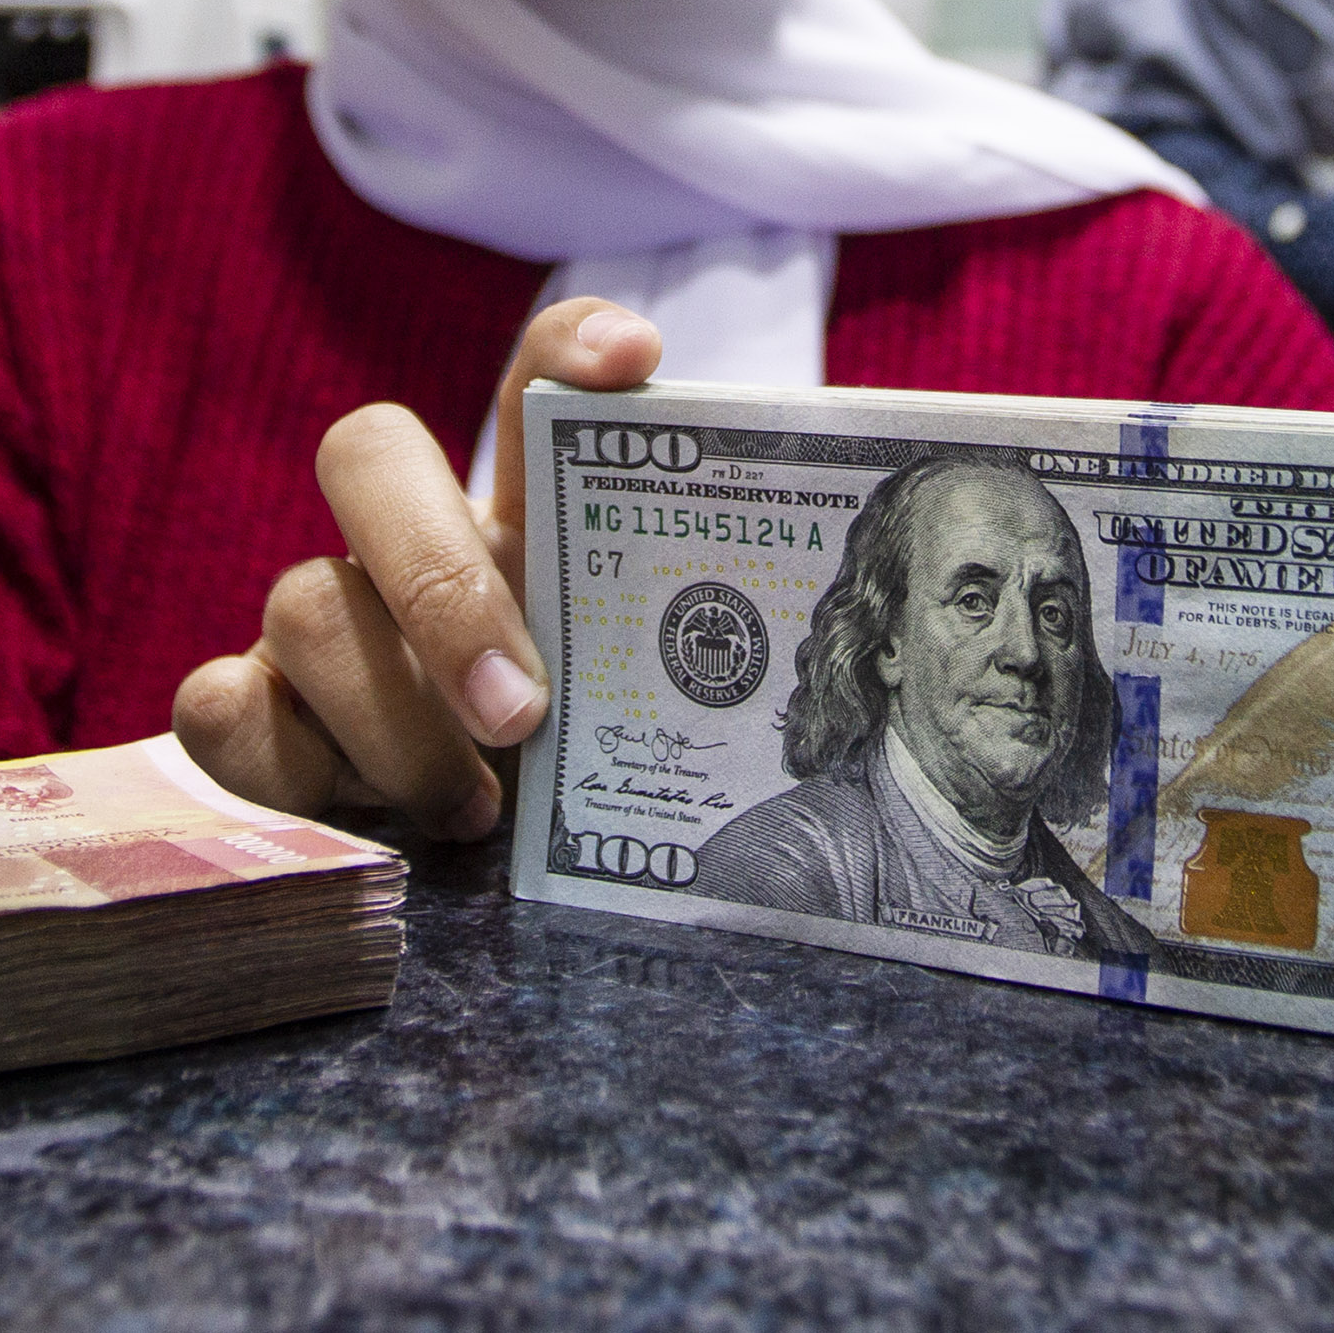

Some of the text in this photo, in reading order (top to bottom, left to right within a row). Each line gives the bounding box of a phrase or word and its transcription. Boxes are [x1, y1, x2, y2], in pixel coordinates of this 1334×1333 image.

[567, 428, 702, 473] 100
[1029, 453, 1100, 477] ONE
[582, 475, 859, 510] FEDERAL RESERVE NOTE
[632, 506, 795, 548] 11545124
[807, 522, 824, 551] A
[1093, 510, 1287, 555] UNITED
[1136, 552, 1207, 588] OF
[674, 589, 754, 624] UNITED STATES
[1178, 612, 1203, 623] FOR
[1208, 614, 1230, 625] ALL
[1285, 620, 1333, 634] PUBLIC
[1208, 602, 1237, 614] THIS
[1242, 604, 1275, 617] NOTE
[1280, 607, 1292, 618] IS
[665, 626, 763, 701] FEDERAL RESERVE SYSTEM
[611, 757, 647, 773] Secretary
[649, 762, 659, 774] of
[661, 762, 671, 775] the
[585, 798, 622, 813] Treasurer
[623, 803, 633, 816] of
[634, 804, 646, 816] the
[648, 806, 676, 820] United
[568, 831, 699, 888] 100
[898, 910, 979, 934] FRANKLIN
